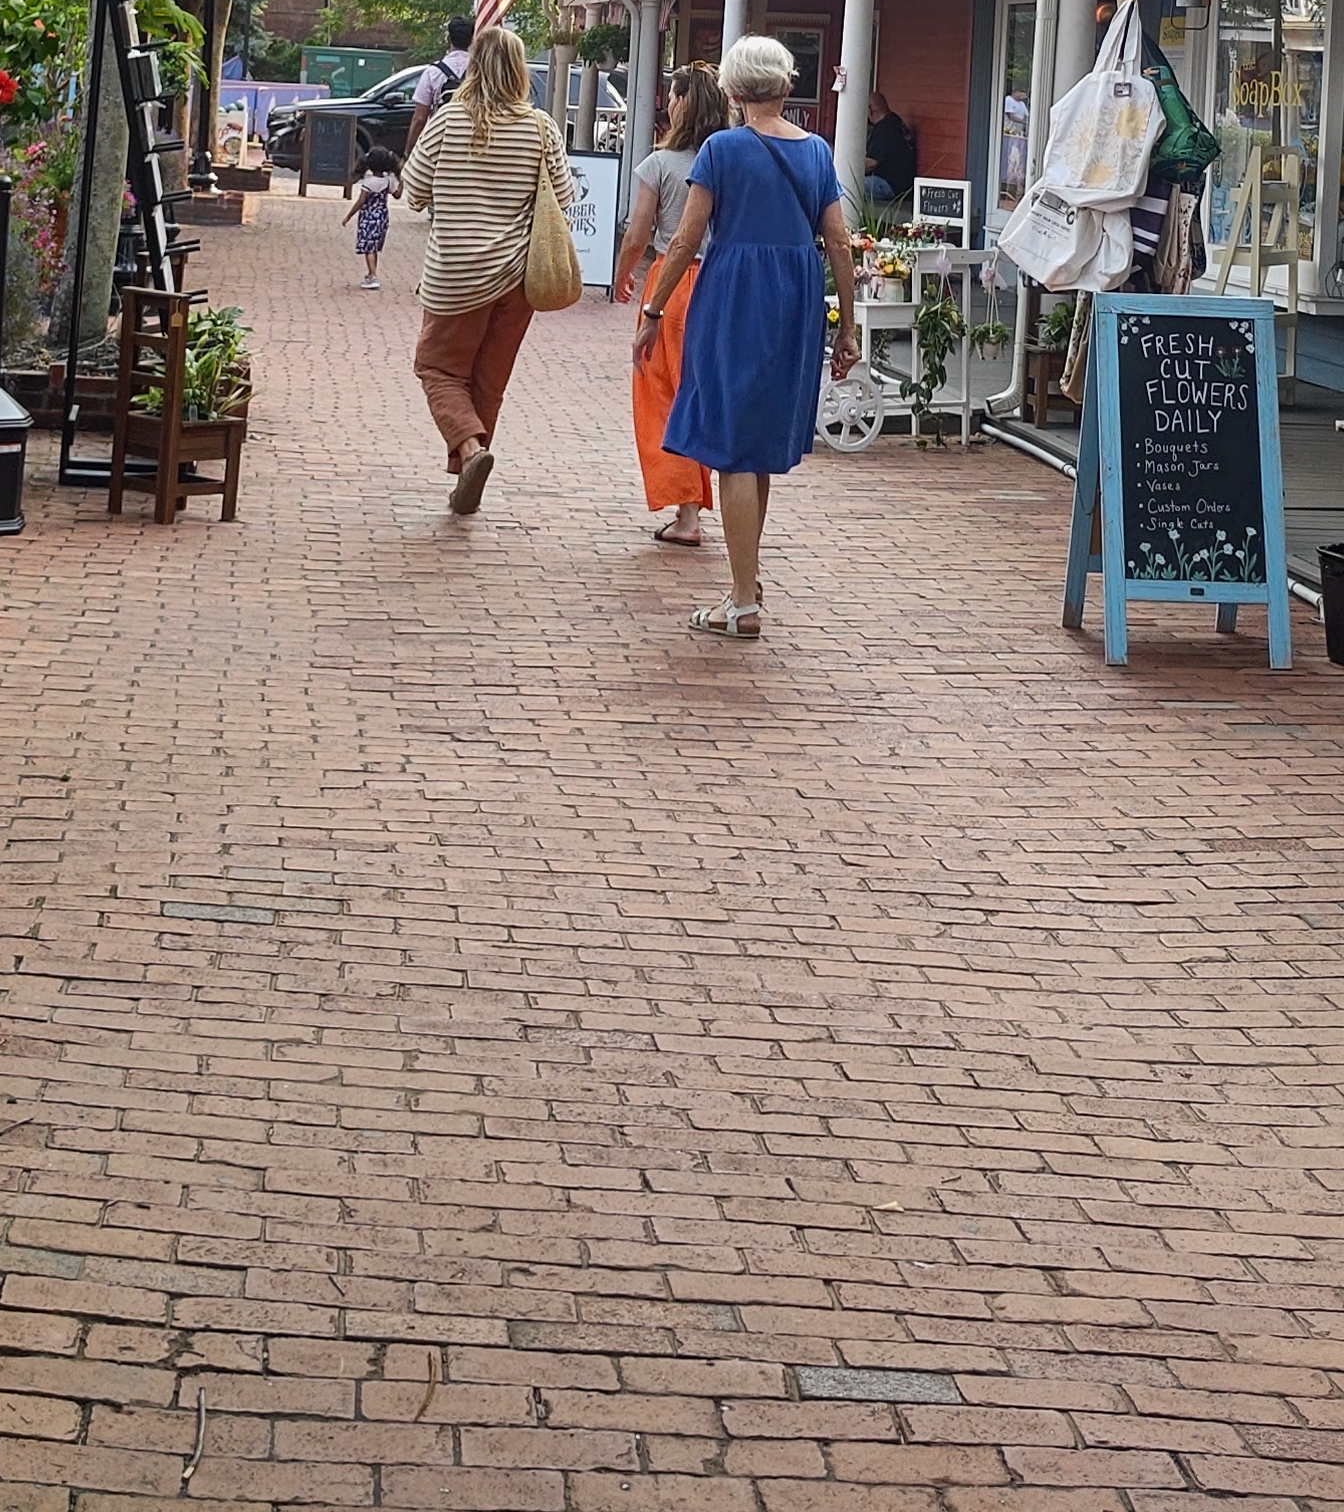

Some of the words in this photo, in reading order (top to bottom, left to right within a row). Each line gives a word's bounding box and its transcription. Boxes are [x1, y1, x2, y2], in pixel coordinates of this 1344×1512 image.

[1232, 68, 1303, 118] SoapBox
[927, 188, 946, 199] Fresh
[1141, 333, 1214, 358] FRESH
[1160, 358, 1211, 380] CUT
[1146, 379, 1249, 410] FLOWERS
[1155, 409, 1222, 433] DAILY
[1144, 438, 1209, 462] Bouquets
[1144, 459, 1184, 474] Mason
[1187, 460, 1219, 477] Jars
[1146, 478, 1181, 493] Vases
[1147, 497, 1191, 514] Custom
[1196, 498, 1231, 514] Orders
[1146, 517, 1184, 531] Single
[1190, 518, 1214, 529] Cuts
